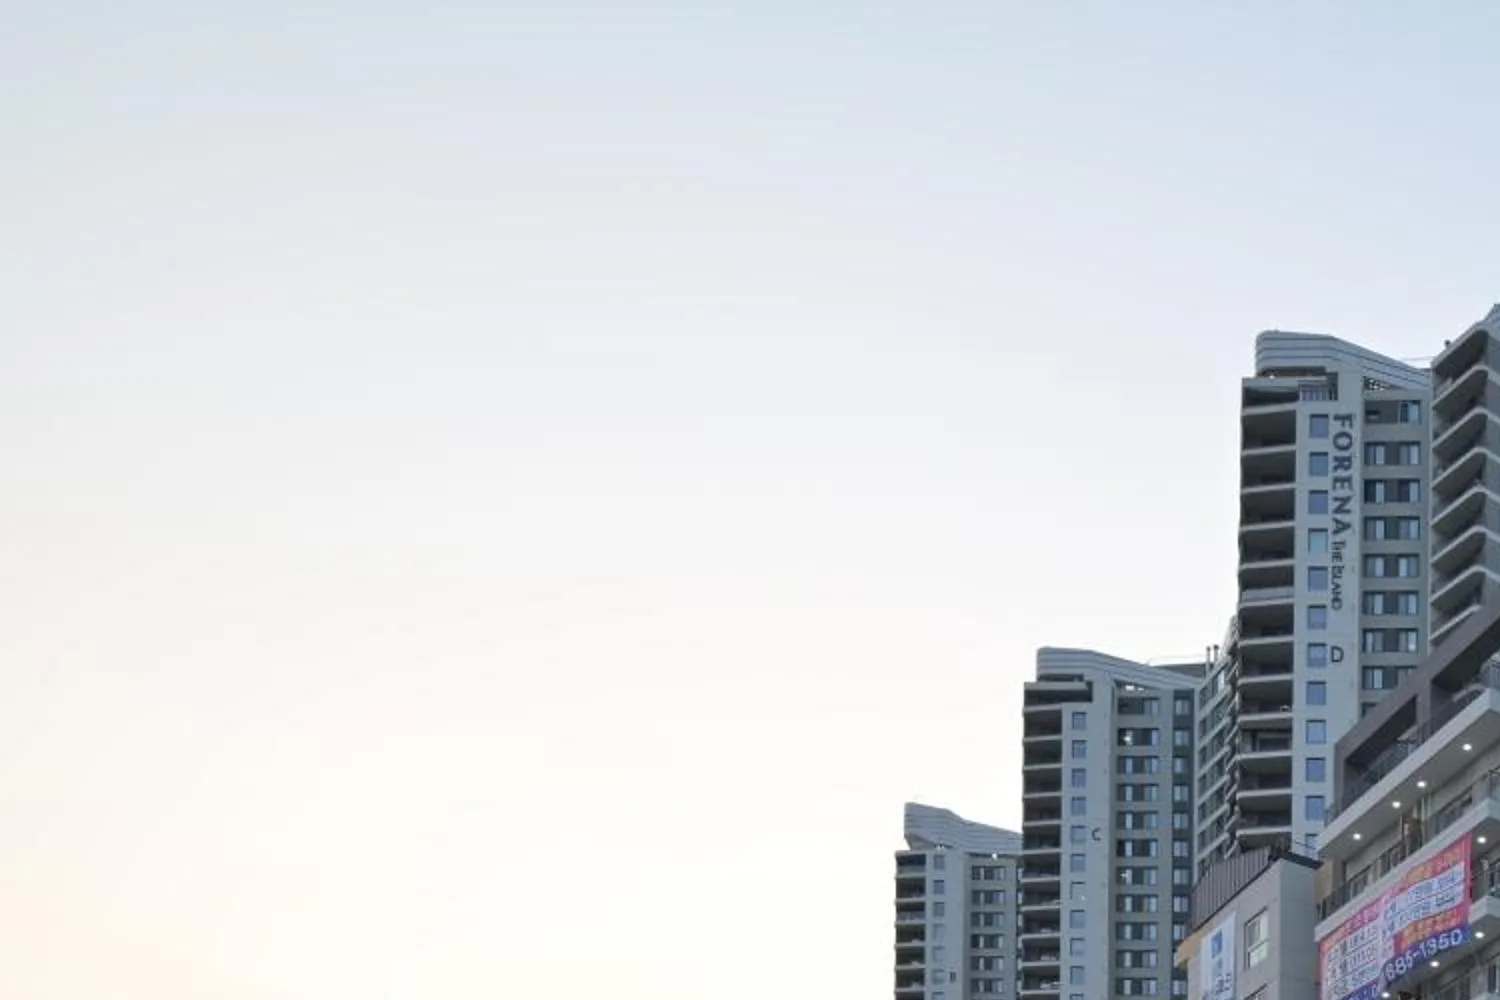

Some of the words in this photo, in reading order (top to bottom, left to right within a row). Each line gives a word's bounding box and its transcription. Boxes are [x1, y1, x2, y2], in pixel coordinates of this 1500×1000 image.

[1332, 413, 1352, 535] FORENA
[1331, 645, 1345, 662] D
[1092, 828, 1102, 841] C
